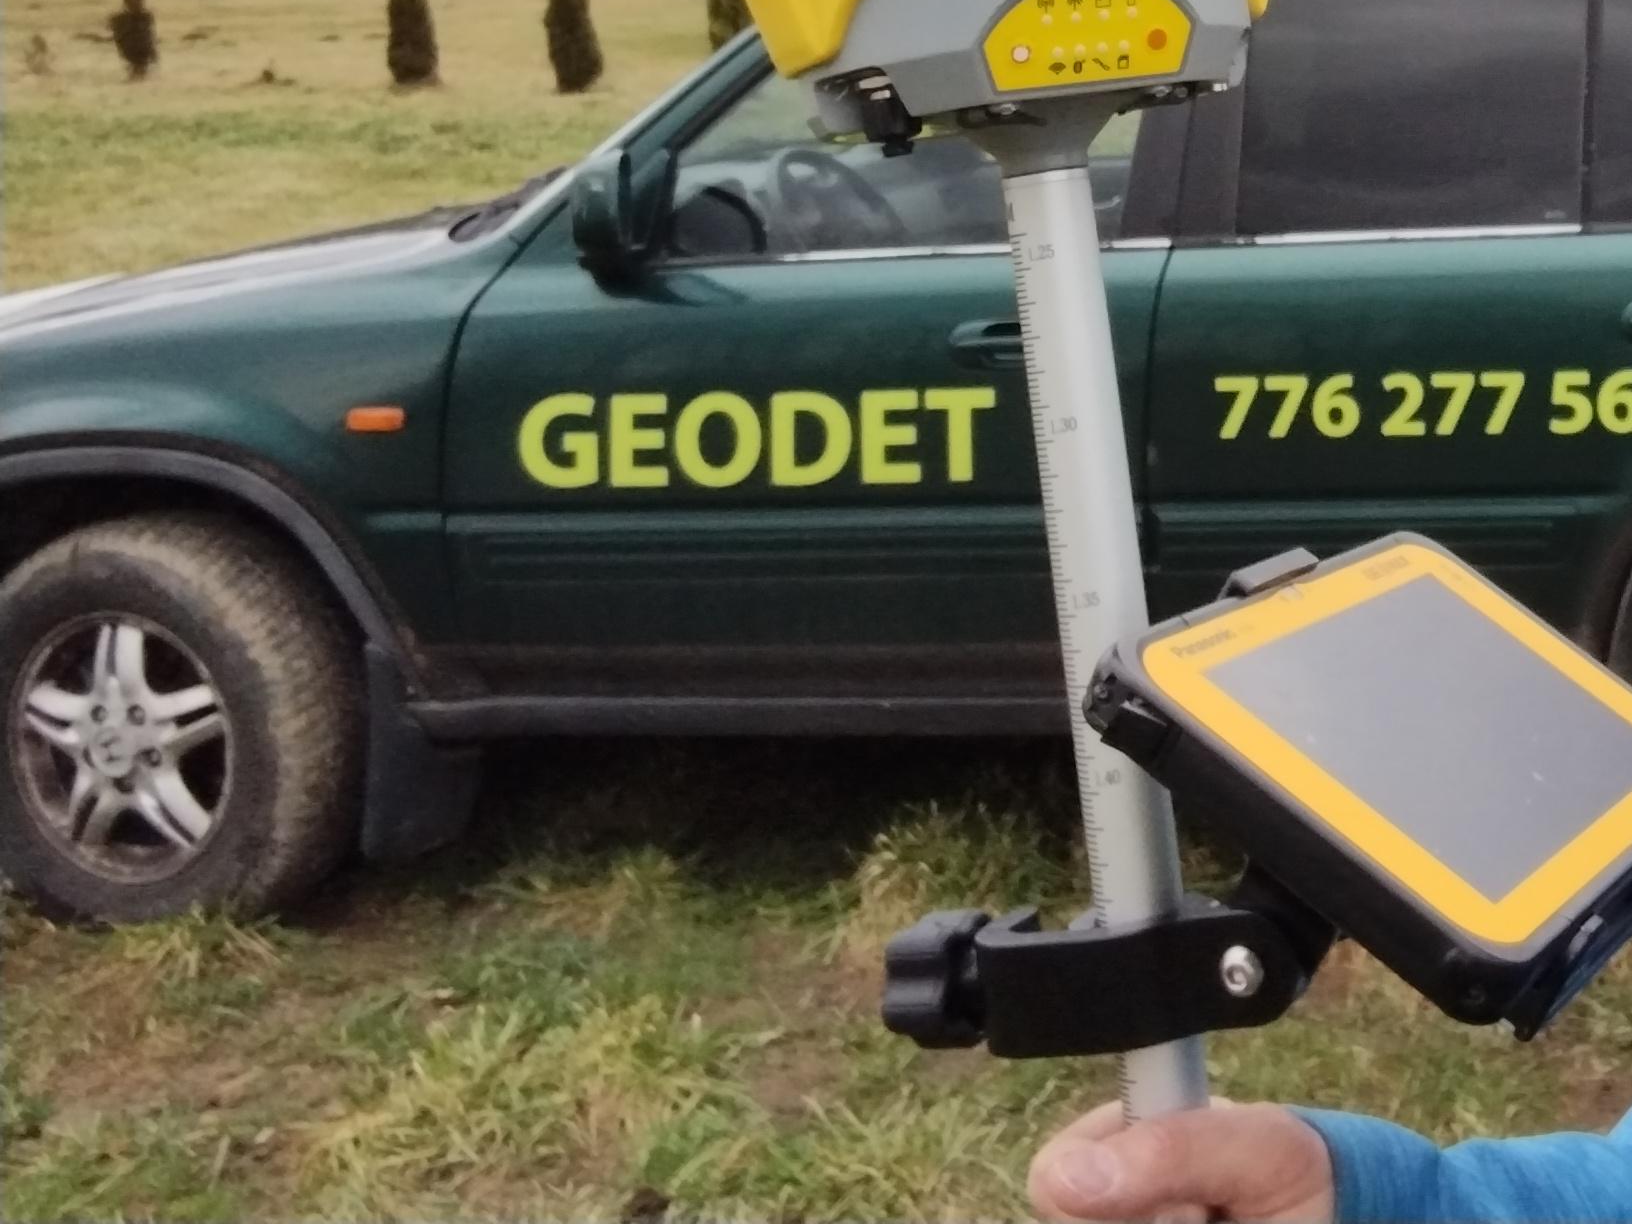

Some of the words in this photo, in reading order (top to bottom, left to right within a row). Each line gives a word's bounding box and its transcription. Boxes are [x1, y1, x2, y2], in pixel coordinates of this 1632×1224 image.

[518, 387, 996, 488] GEODET
[1214, 373, 1361, 440] 776
[1380, 371, 1525, 437] 277
